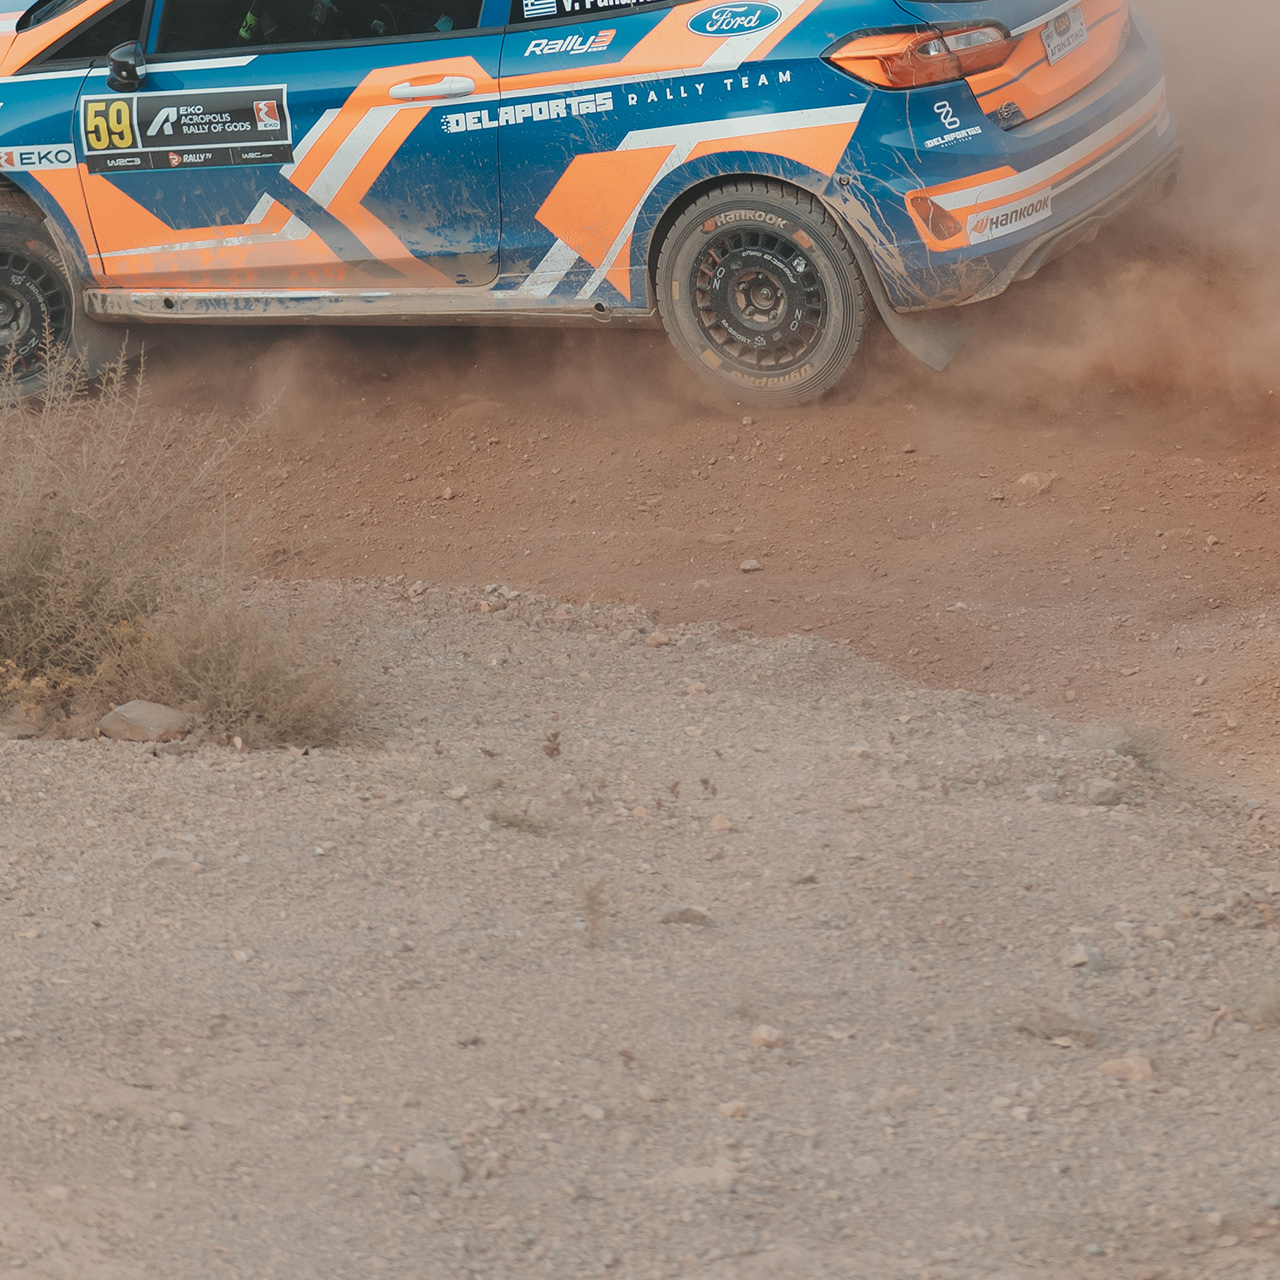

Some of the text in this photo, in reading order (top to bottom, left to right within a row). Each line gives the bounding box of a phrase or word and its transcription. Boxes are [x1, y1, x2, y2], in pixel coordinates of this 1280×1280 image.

[705, 5, 761, 32] Ford
[523, 29, 617, 57] Rally3
[628, 82, 705, 106] RALLY
[724, 70, 792, 91] TEAM
[179, 105, 204, 115] EKO
[181, 113, 231, 124] ACROPOLIS
[86, 100, 134, 150] 59
[182, 122, 252, 134] RALLY OF GODS
[19, 149, 72, 166] EKO
